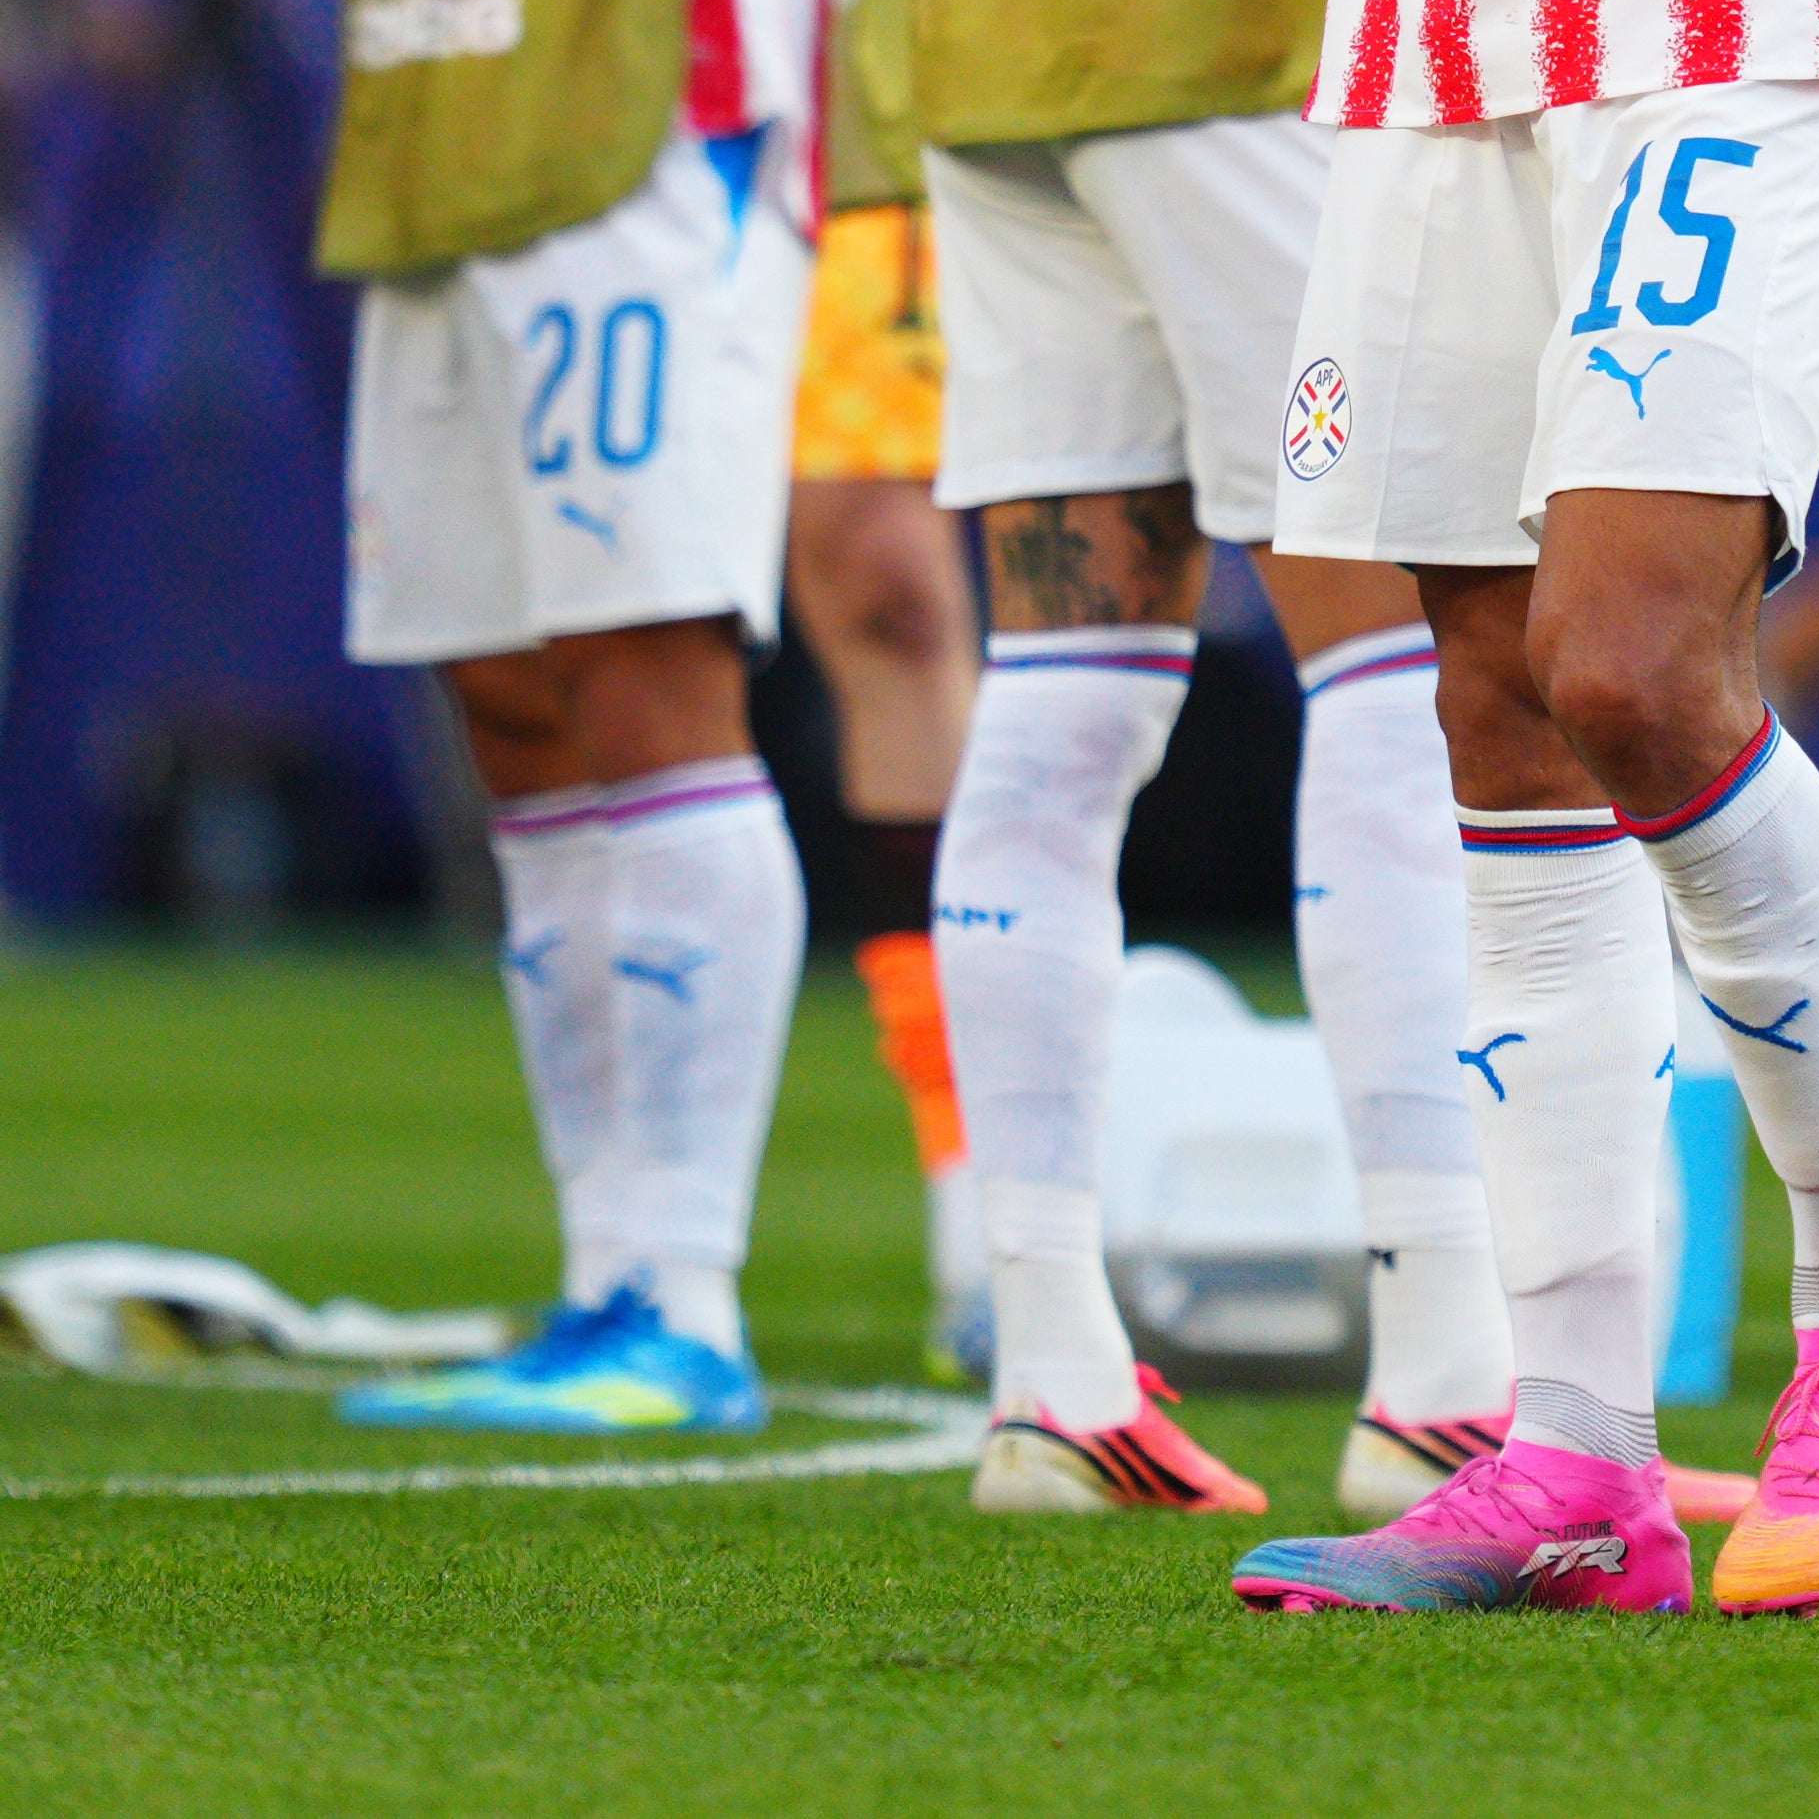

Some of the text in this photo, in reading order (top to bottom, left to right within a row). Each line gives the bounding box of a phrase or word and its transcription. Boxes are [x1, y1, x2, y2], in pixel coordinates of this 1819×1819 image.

[1571, 137, 1763, 338] 15
[523, 299, 669, 475] 20
[1315, 369, 1334, 388] APF
[1564, 1519, 1616, 1540] FUTURE
